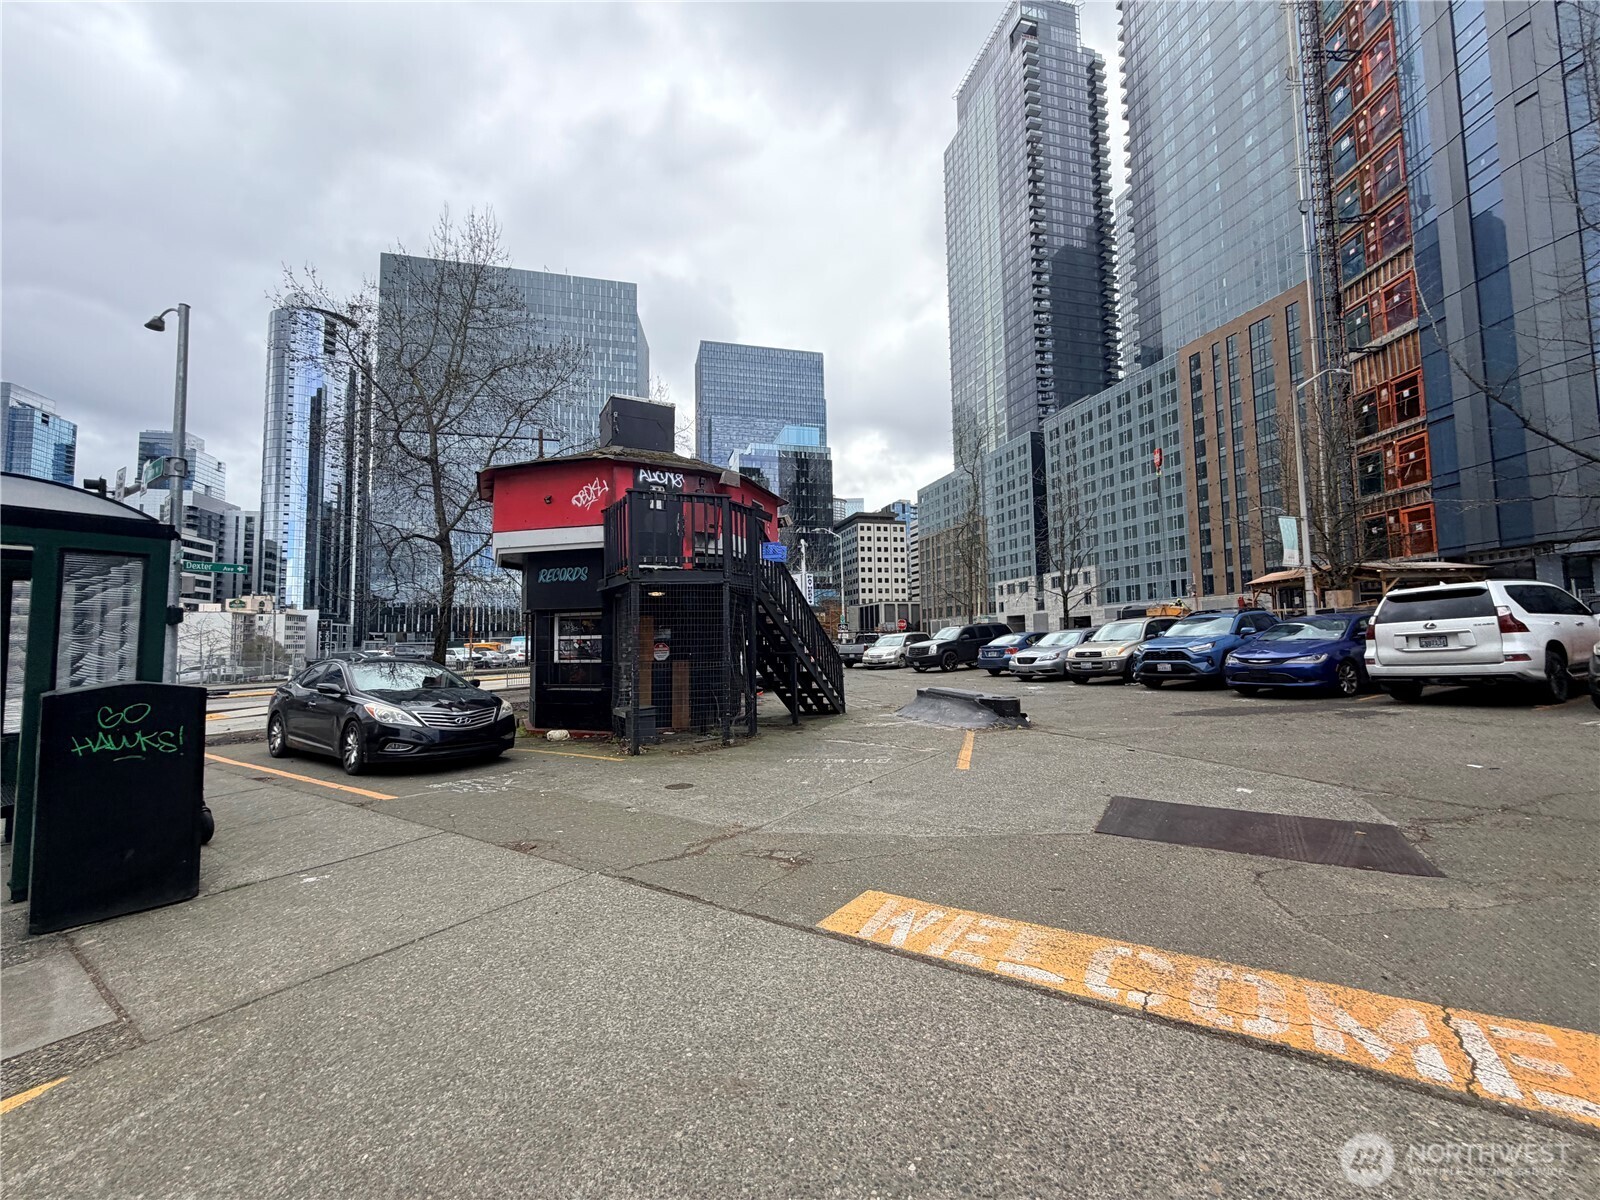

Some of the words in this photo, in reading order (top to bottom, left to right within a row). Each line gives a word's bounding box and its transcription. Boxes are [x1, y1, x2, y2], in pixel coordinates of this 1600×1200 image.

[186, 561, 212, 570] Dexter
[537, 566, 589, 583] RECORDS
[97, 702, 151, 729] GO
[71, 725, 184, 756] HAWKS!
[858, 898, 1600, 1120] WELCOME
